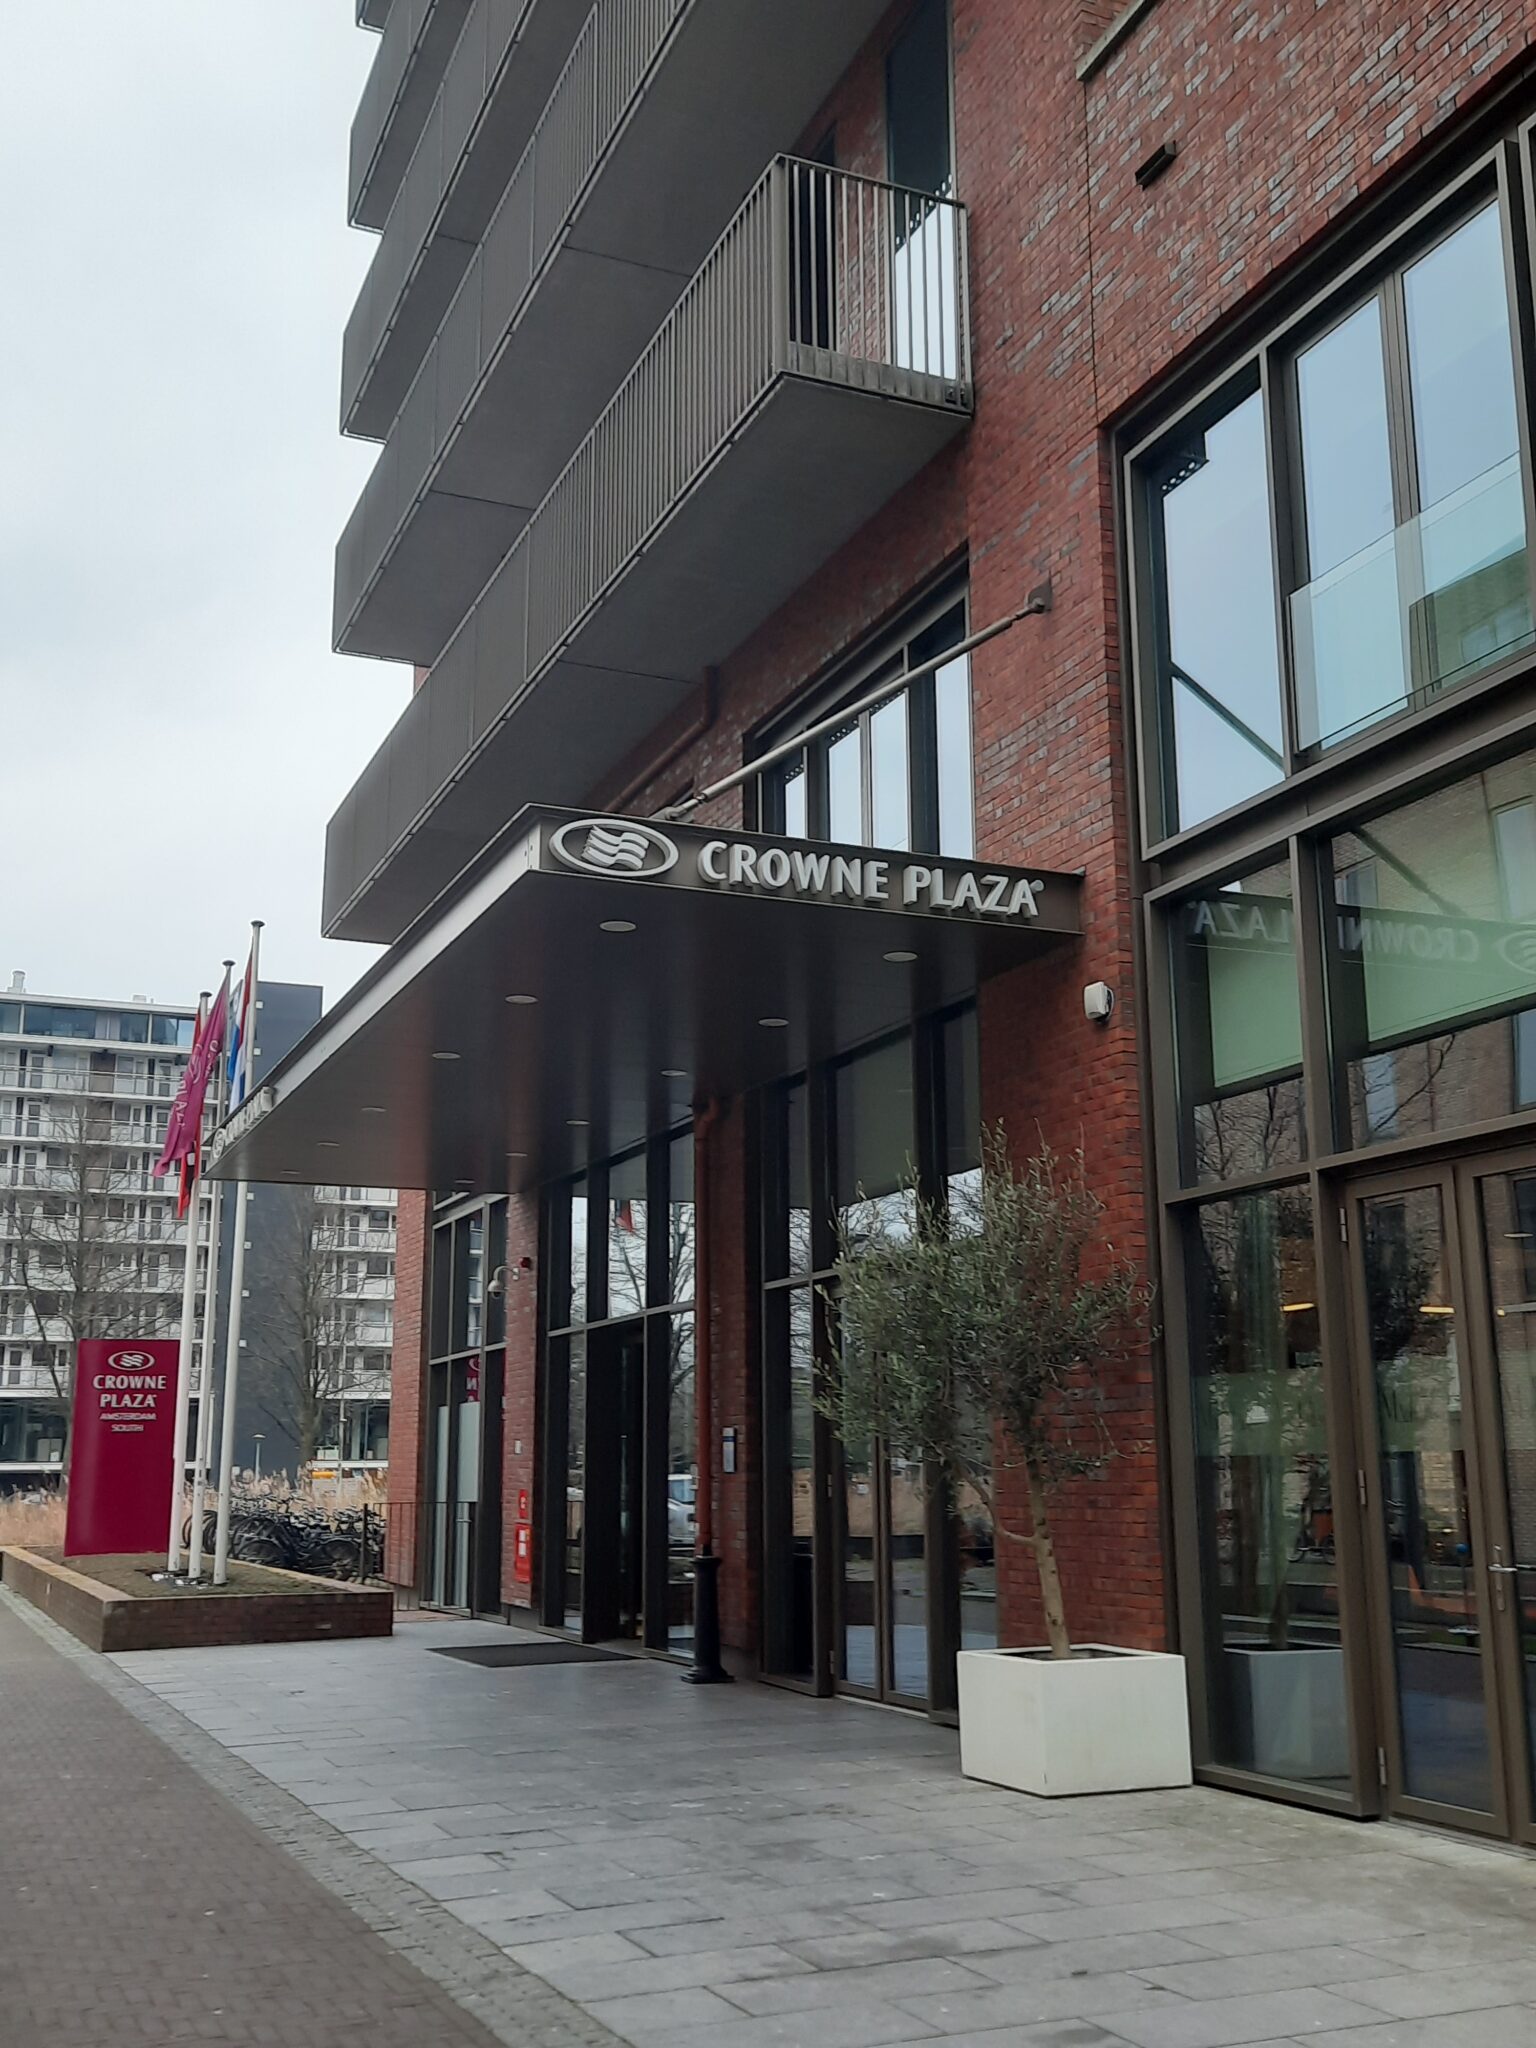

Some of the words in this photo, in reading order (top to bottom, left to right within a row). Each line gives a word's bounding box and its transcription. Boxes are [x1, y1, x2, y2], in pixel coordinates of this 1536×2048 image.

[699, 841, 889, 900] CROWNE
[903, 865, 1044, 917] PLAZA
[93, 1375, 167, 1389] CROWNE
[100, 1393, 157, 1408] PLAZA
